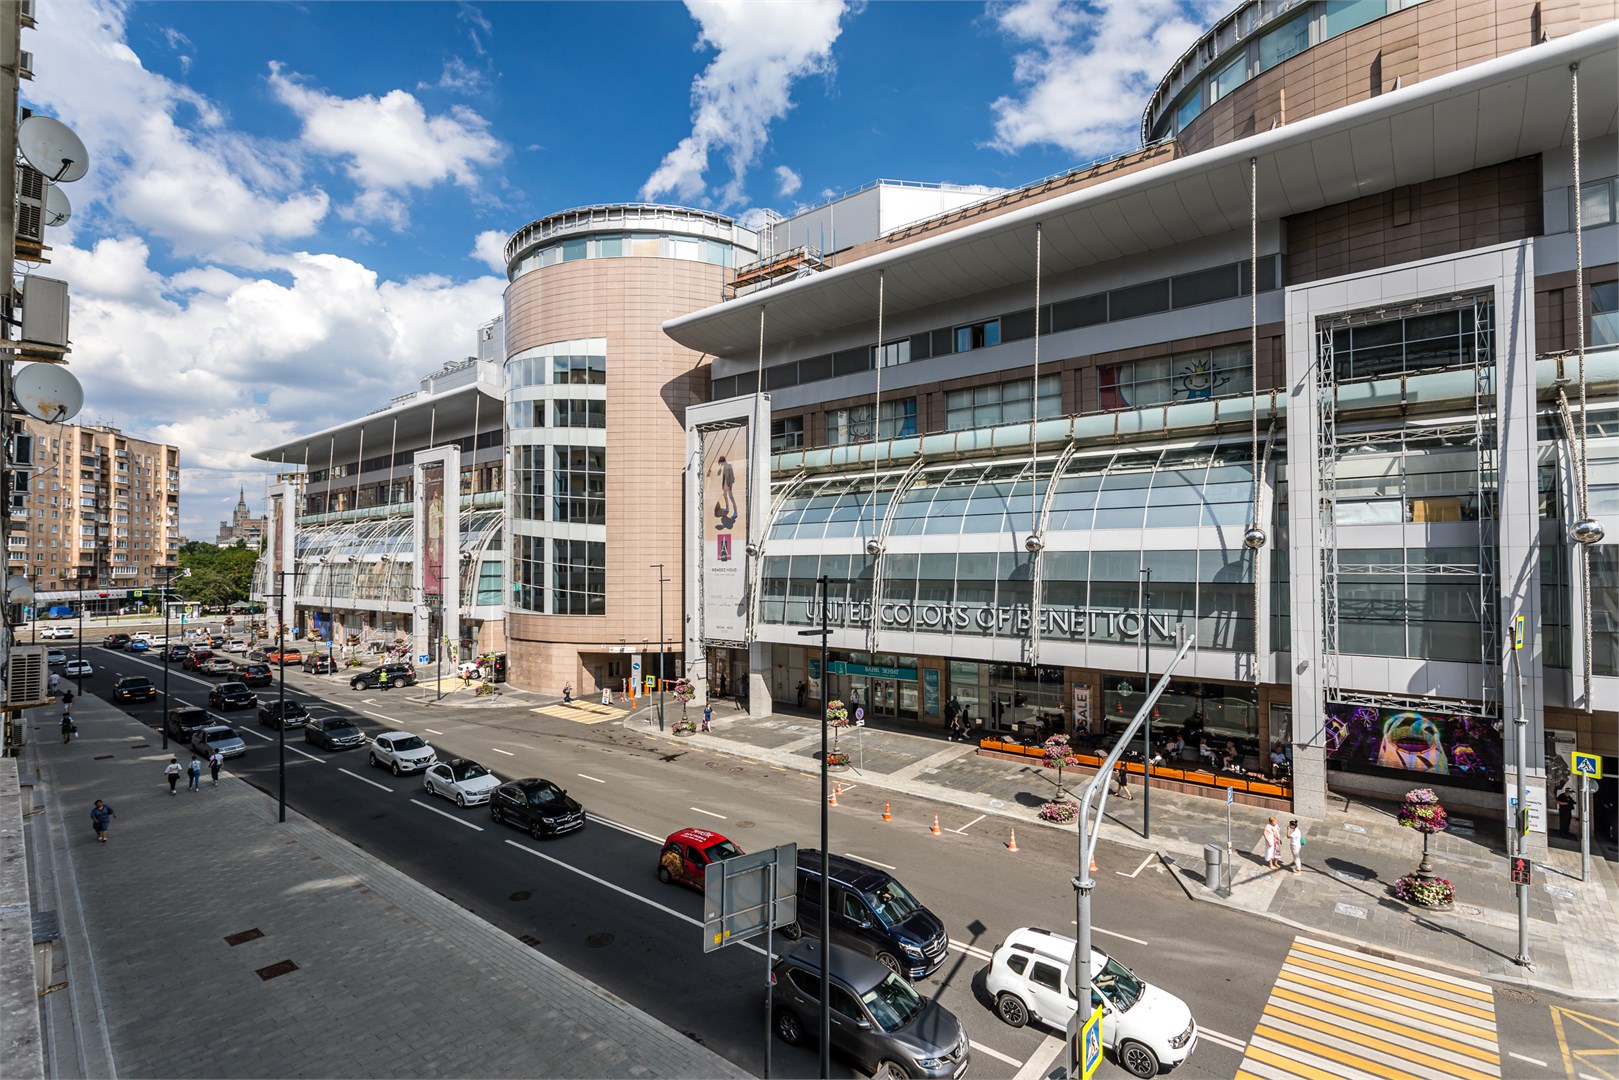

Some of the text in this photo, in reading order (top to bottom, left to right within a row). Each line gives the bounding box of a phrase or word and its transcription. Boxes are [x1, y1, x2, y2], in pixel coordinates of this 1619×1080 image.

[805, 599, 873, 622] UNITED
[880, 602, 971, 628] COLORS
[976, 604, 1011, 629] OF
[1076, 693, 1088, 728] SALE
